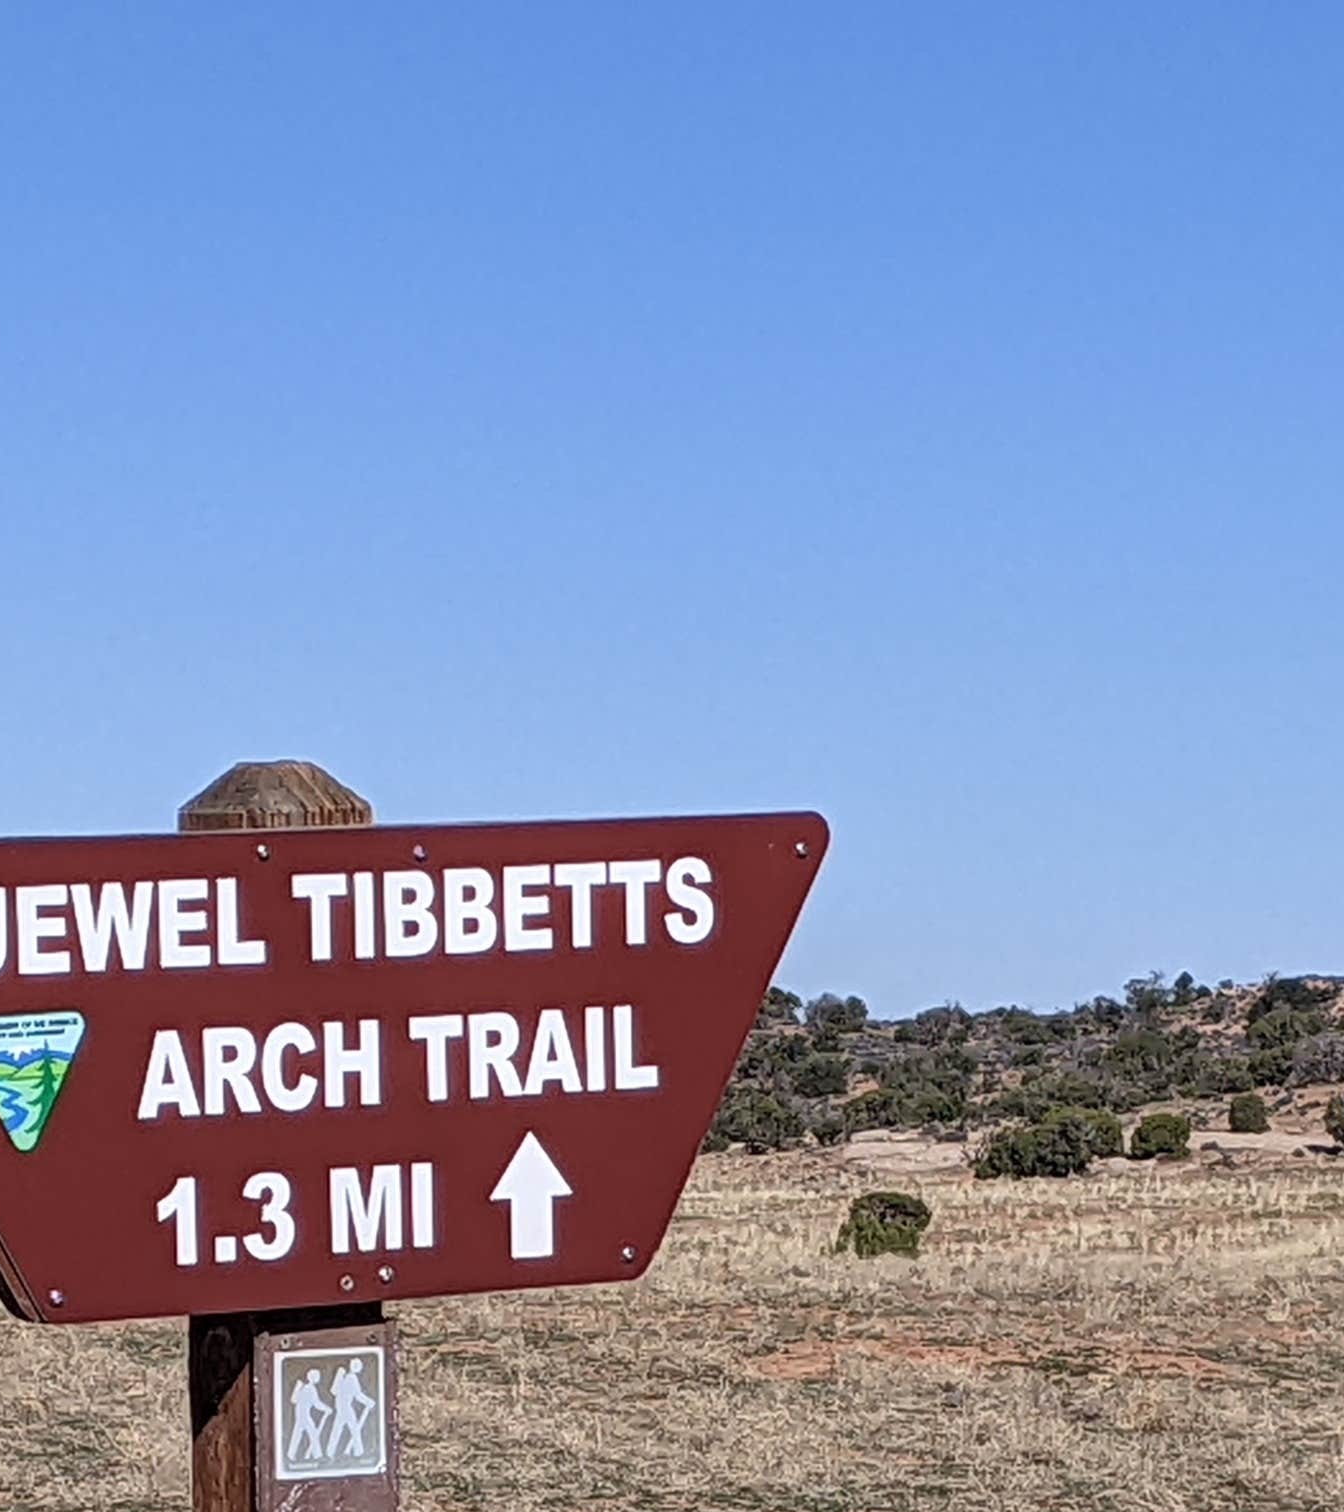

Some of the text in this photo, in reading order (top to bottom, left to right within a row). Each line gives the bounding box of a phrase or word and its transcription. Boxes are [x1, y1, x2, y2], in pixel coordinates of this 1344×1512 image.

[291, 856, 714, 961] TIBBETTS
[137, 1004, 659, 1120] ARCH TRAIL
[156, 1162, 434, 1266] 1.3 MI
